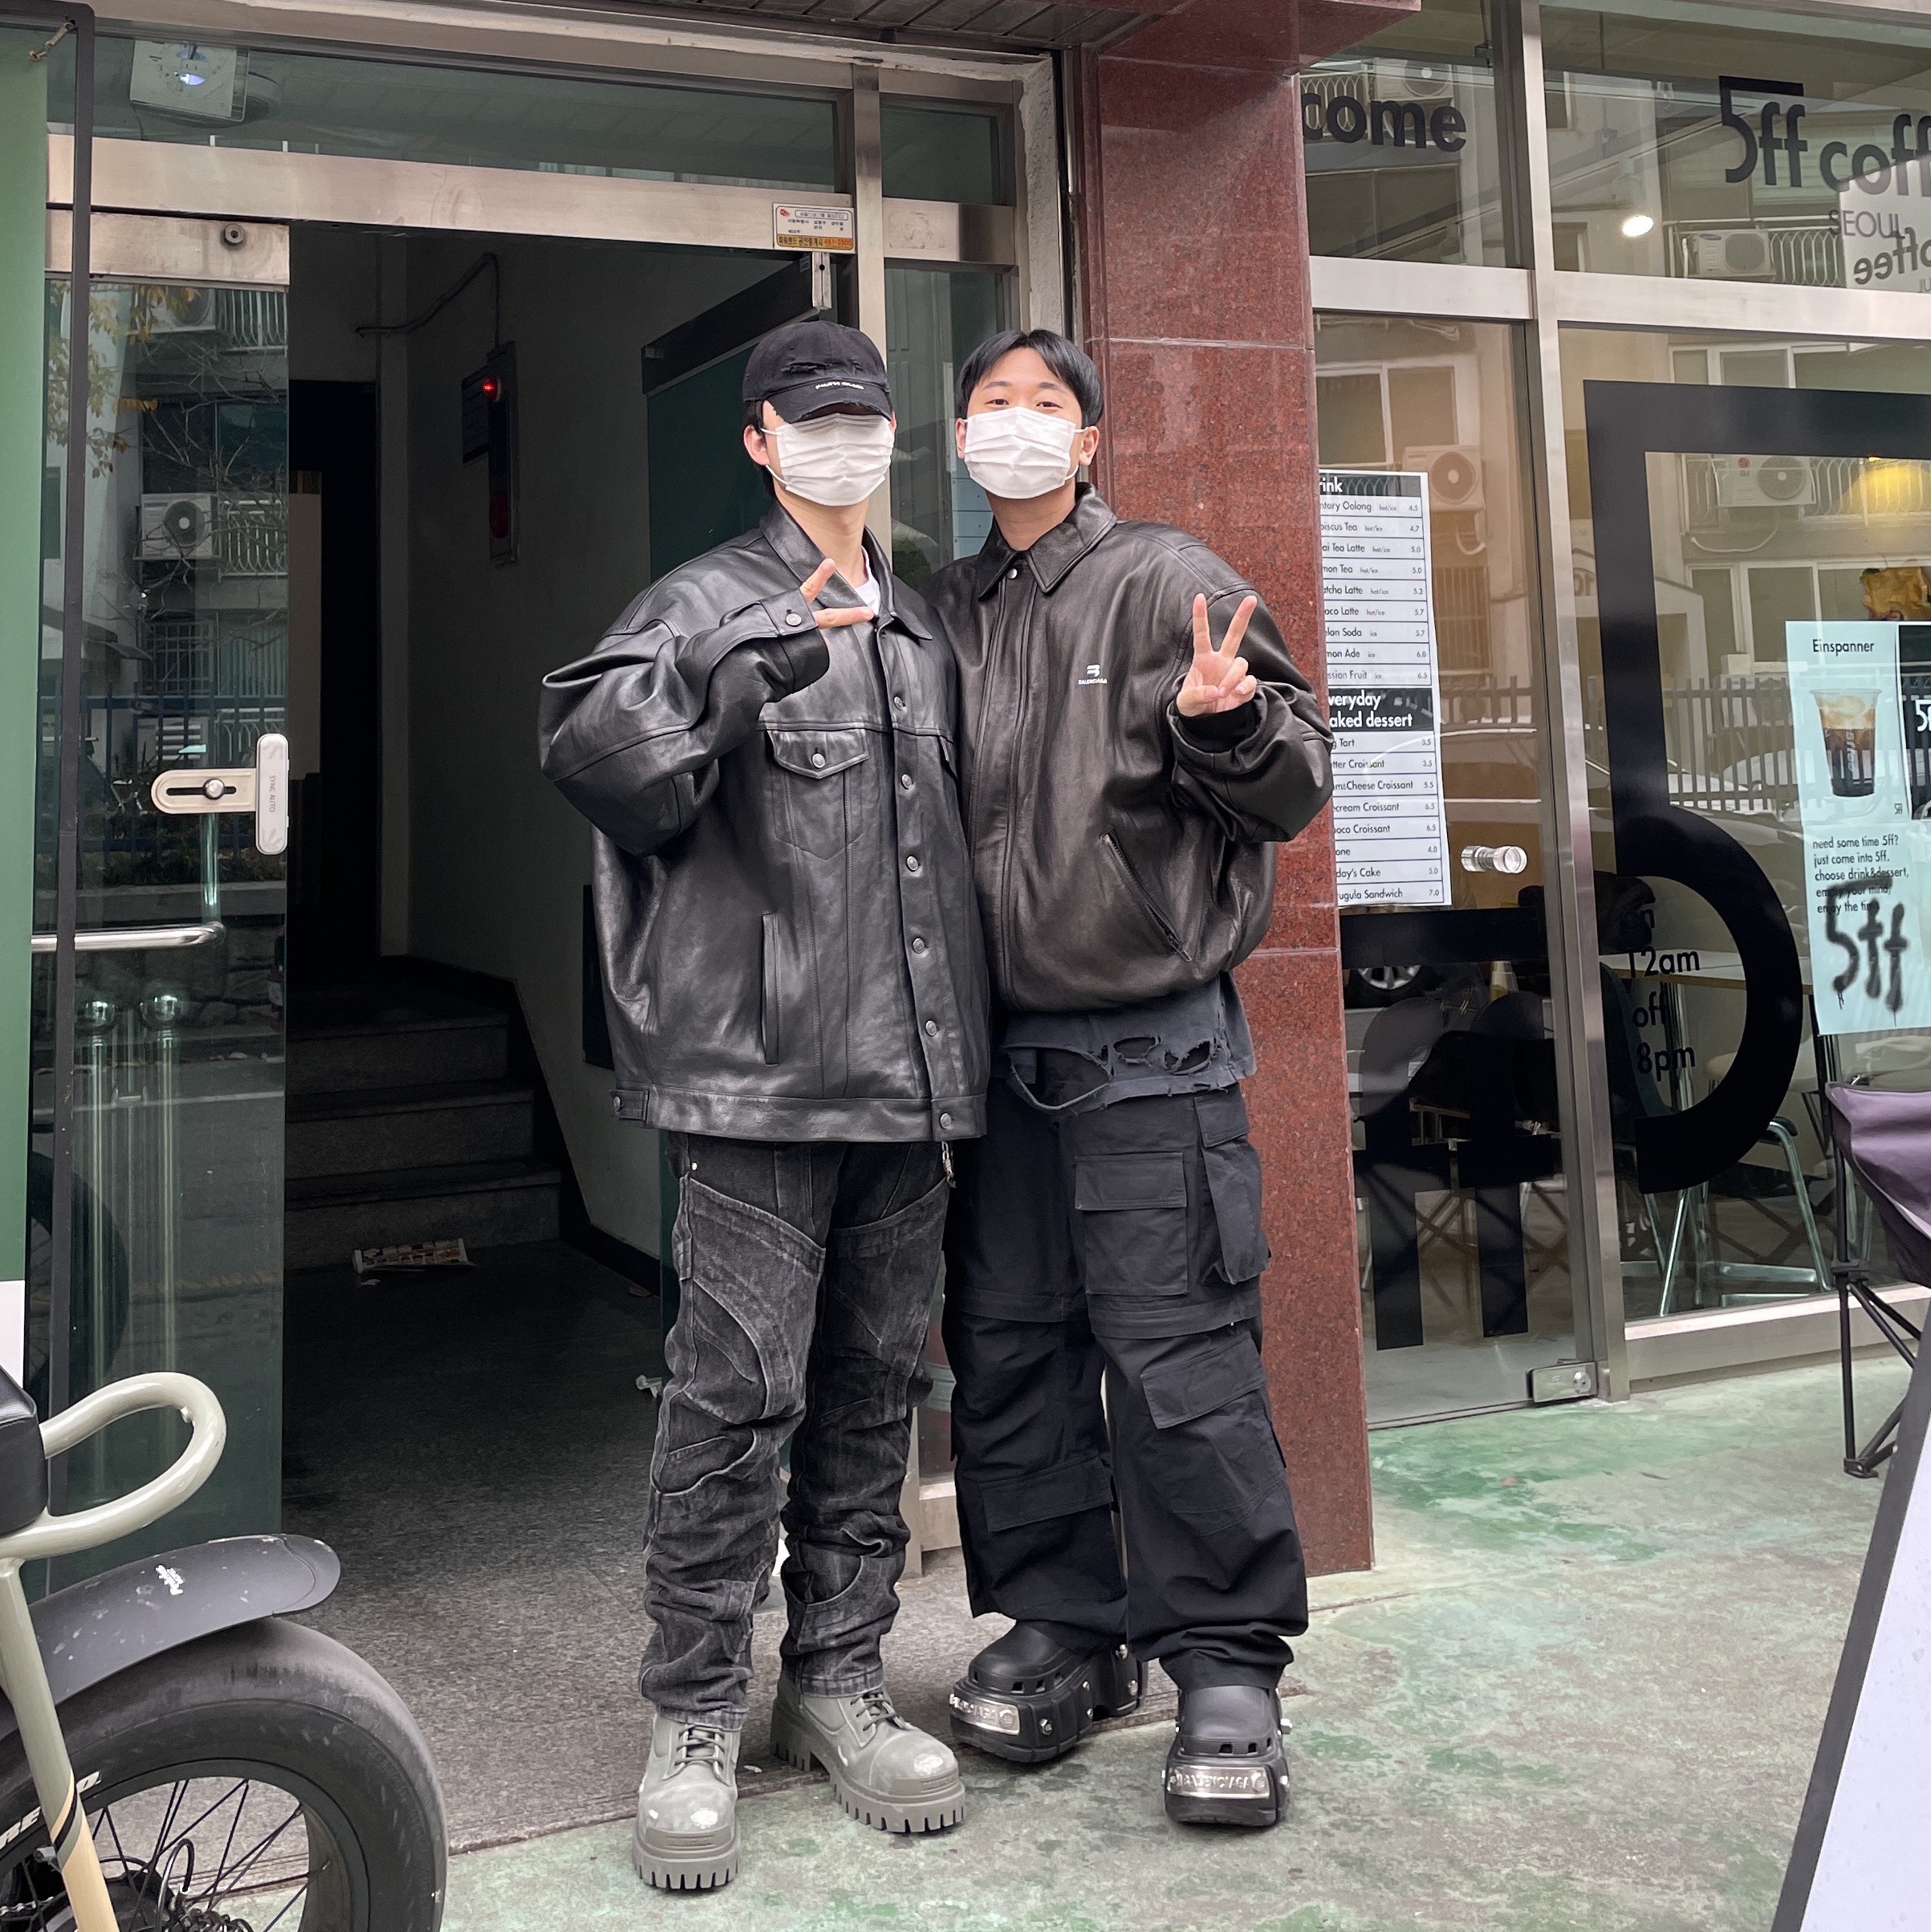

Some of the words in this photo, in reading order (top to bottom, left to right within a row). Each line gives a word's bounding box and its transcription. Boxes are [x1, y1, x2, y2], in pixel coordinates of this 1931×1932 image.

[1302, 92, 1466, 153] come
[1719, 75, 1807, 188] 5ff
[1828, 209, 1905, 238] SEOUL
[1343, 500, 1372, 512] Oolong
[1345, 523, 1357, 531] Tea
[1332, 543, 1344, 552] Tea
[1347, 543, 1364, 553] Latte
[1340, 564, 1352, 573] Tea
[1344, 585, 1363, 595] Latte
[1340, 606, 1359, 616] Latte
[1342, 627, 1362, 637] Soda
[1813, 638, 1875, 657] Einspanner
[1344, 648, 1360, 658] Ade
[1349, 669, 1367, 679] Fruit
[1366, 710, 1413, 727] dessert
[1340, 738, 1355, 747] Tart
[1348, 759, 1385, 769] Croissant
[1377, 780, 1413, 790] Croissant
[1363, 802, 1400, 811] Croissant
[1353, 824, 1391, 833] Croissant
[1812, 836, 1834, 849] need
[1836, 838, 1860, 848] some
[1861, 836, 1880, 847] time
[1882, 835, 1899, 846] 5ff?
[1813, 853, 1829, 868] just
[1831, 854, 1855, 864] come
[1857, 852, 1873, 864] into
[1360, 867, 1381, 877] Cake
[1815, 869, 1846, 881] choose
[1364, 888, 1403, 899] Sandwich
[1844, 900, 1859, 912] the
[1628, 946, 1700, 978] 12am
[1632, 990, 1670, 1028] off
[1637, 1042, 1696, 1082] 8pm
